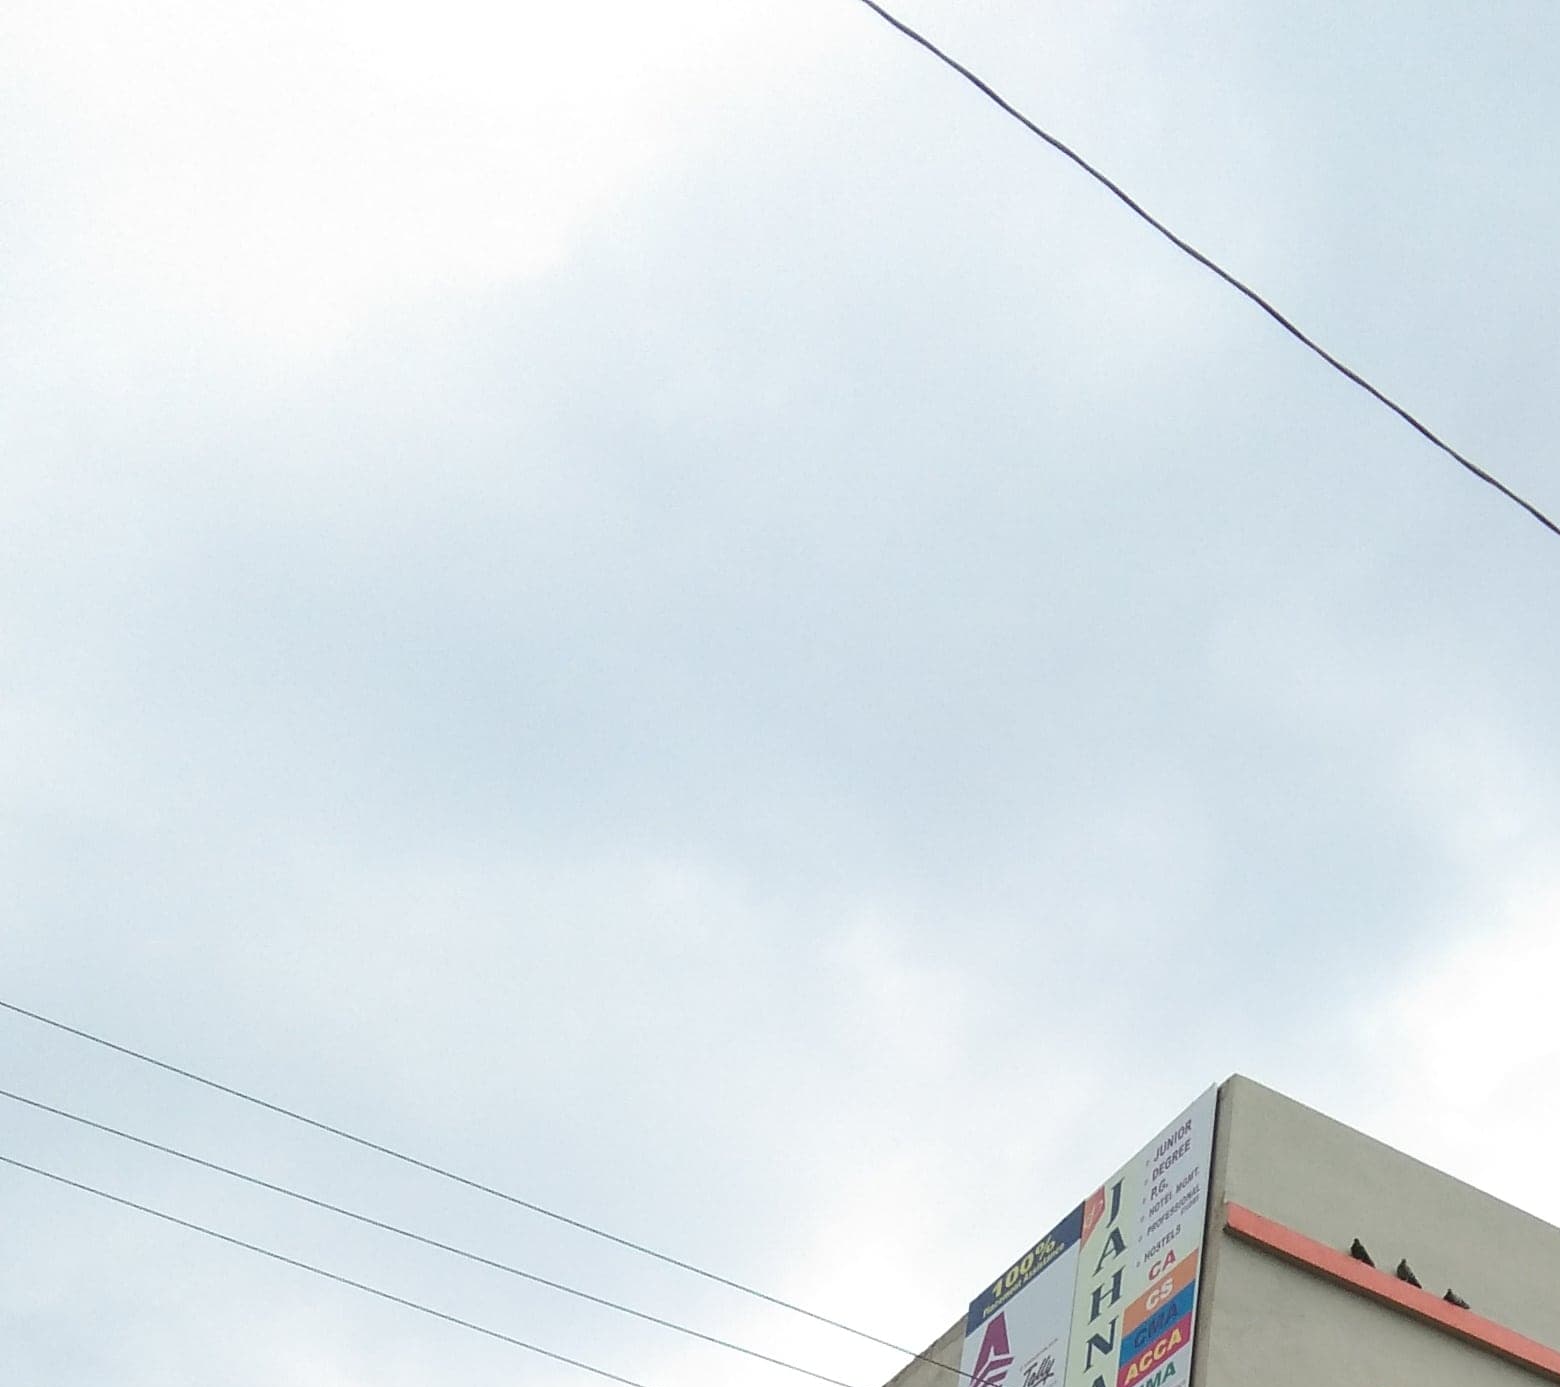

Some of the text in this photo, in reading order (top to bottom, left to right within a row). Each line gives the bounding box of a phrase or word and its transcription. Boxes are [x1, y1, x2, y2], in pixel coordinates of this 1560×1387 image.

[1152, 1139, 1191, 1182] DEGREE
[1153, 1120, 1192, 1162] JUNIOR
[992, 1238, 1056, 1297] 100%
[1148, 1250, 1177, 1281] CA
[1146, 1278, 1174, 1311] CS
[1134, 1303, 1178, 1350] CMA
[1123, 1328, 1183, 1385] ACCA
